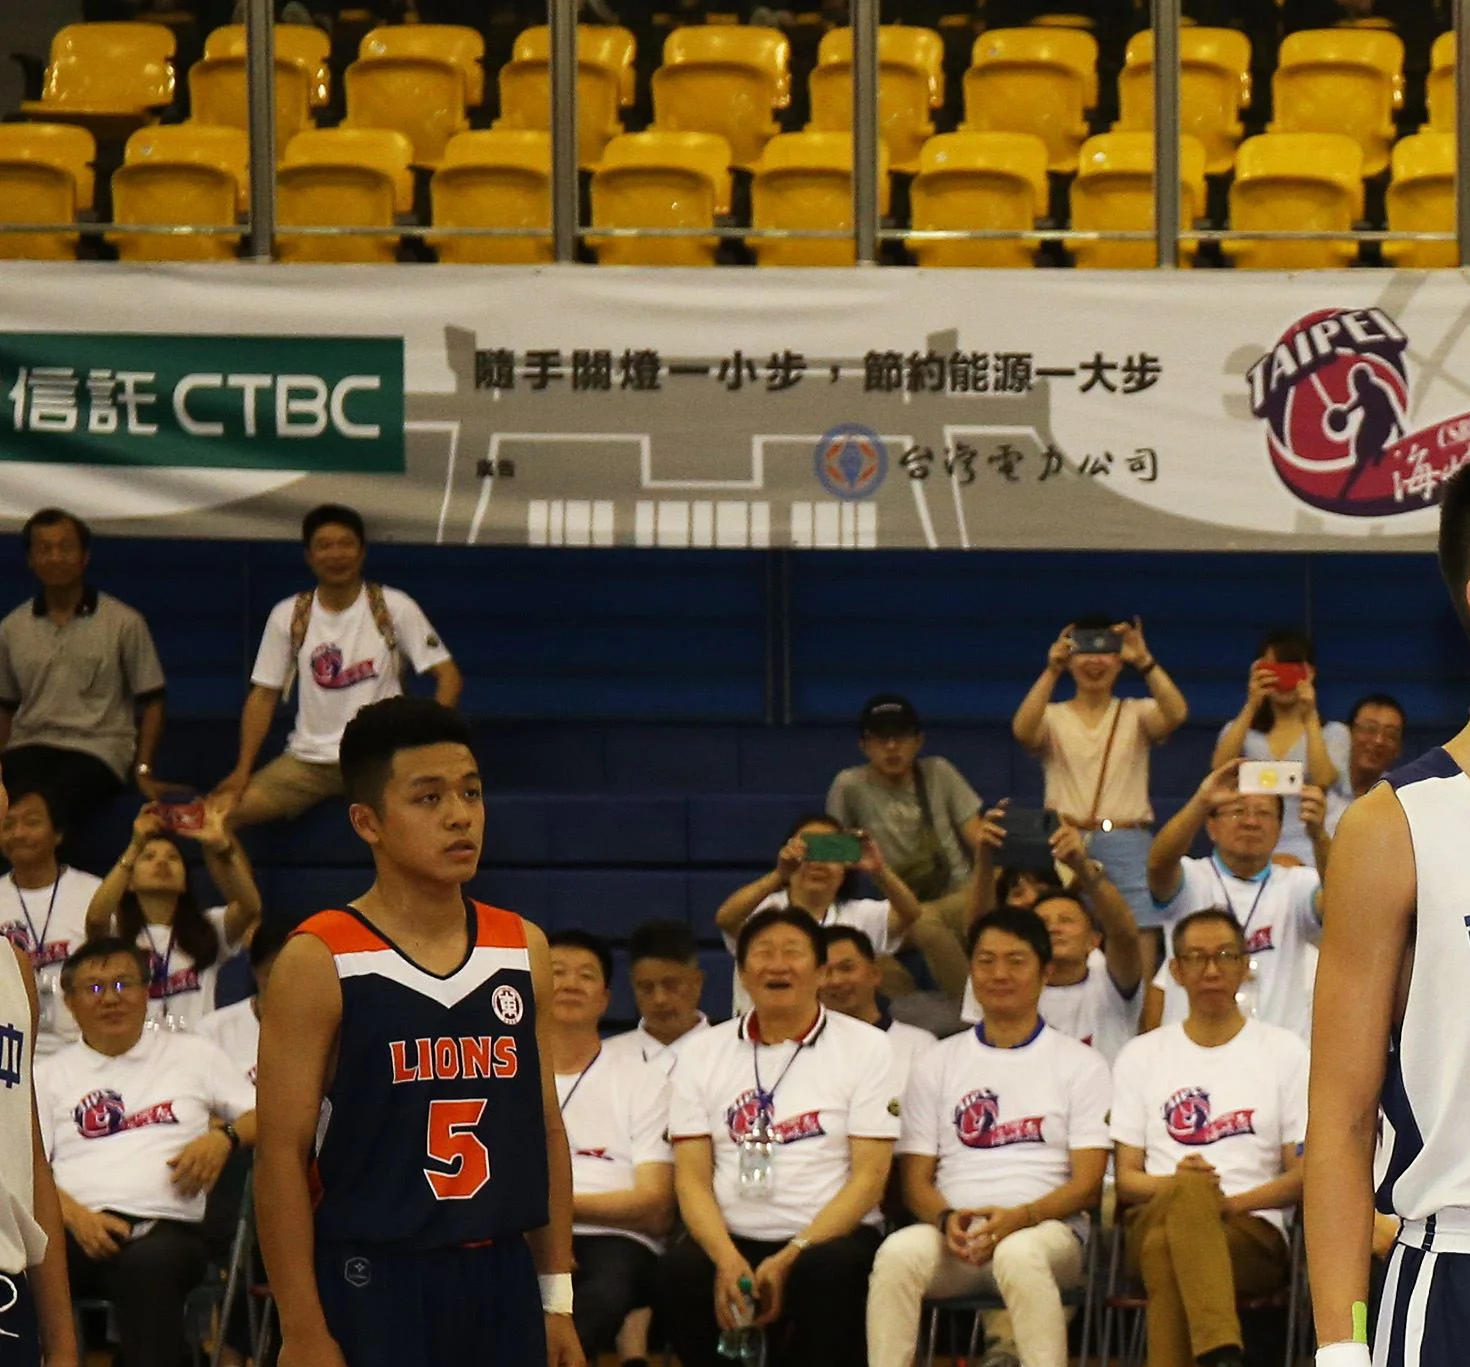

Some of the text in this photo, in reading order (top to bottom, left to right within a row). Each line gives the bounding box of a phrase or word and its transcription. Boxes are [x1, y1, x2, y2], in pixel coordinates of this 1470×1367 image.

[8, 366, 381, 439] 信託 CTBC
[1247, 308, 1406, 413] TAIPEI
[389, 1035, 518, 1084] LIONS
[423, 1098, 490, 1200] 5
